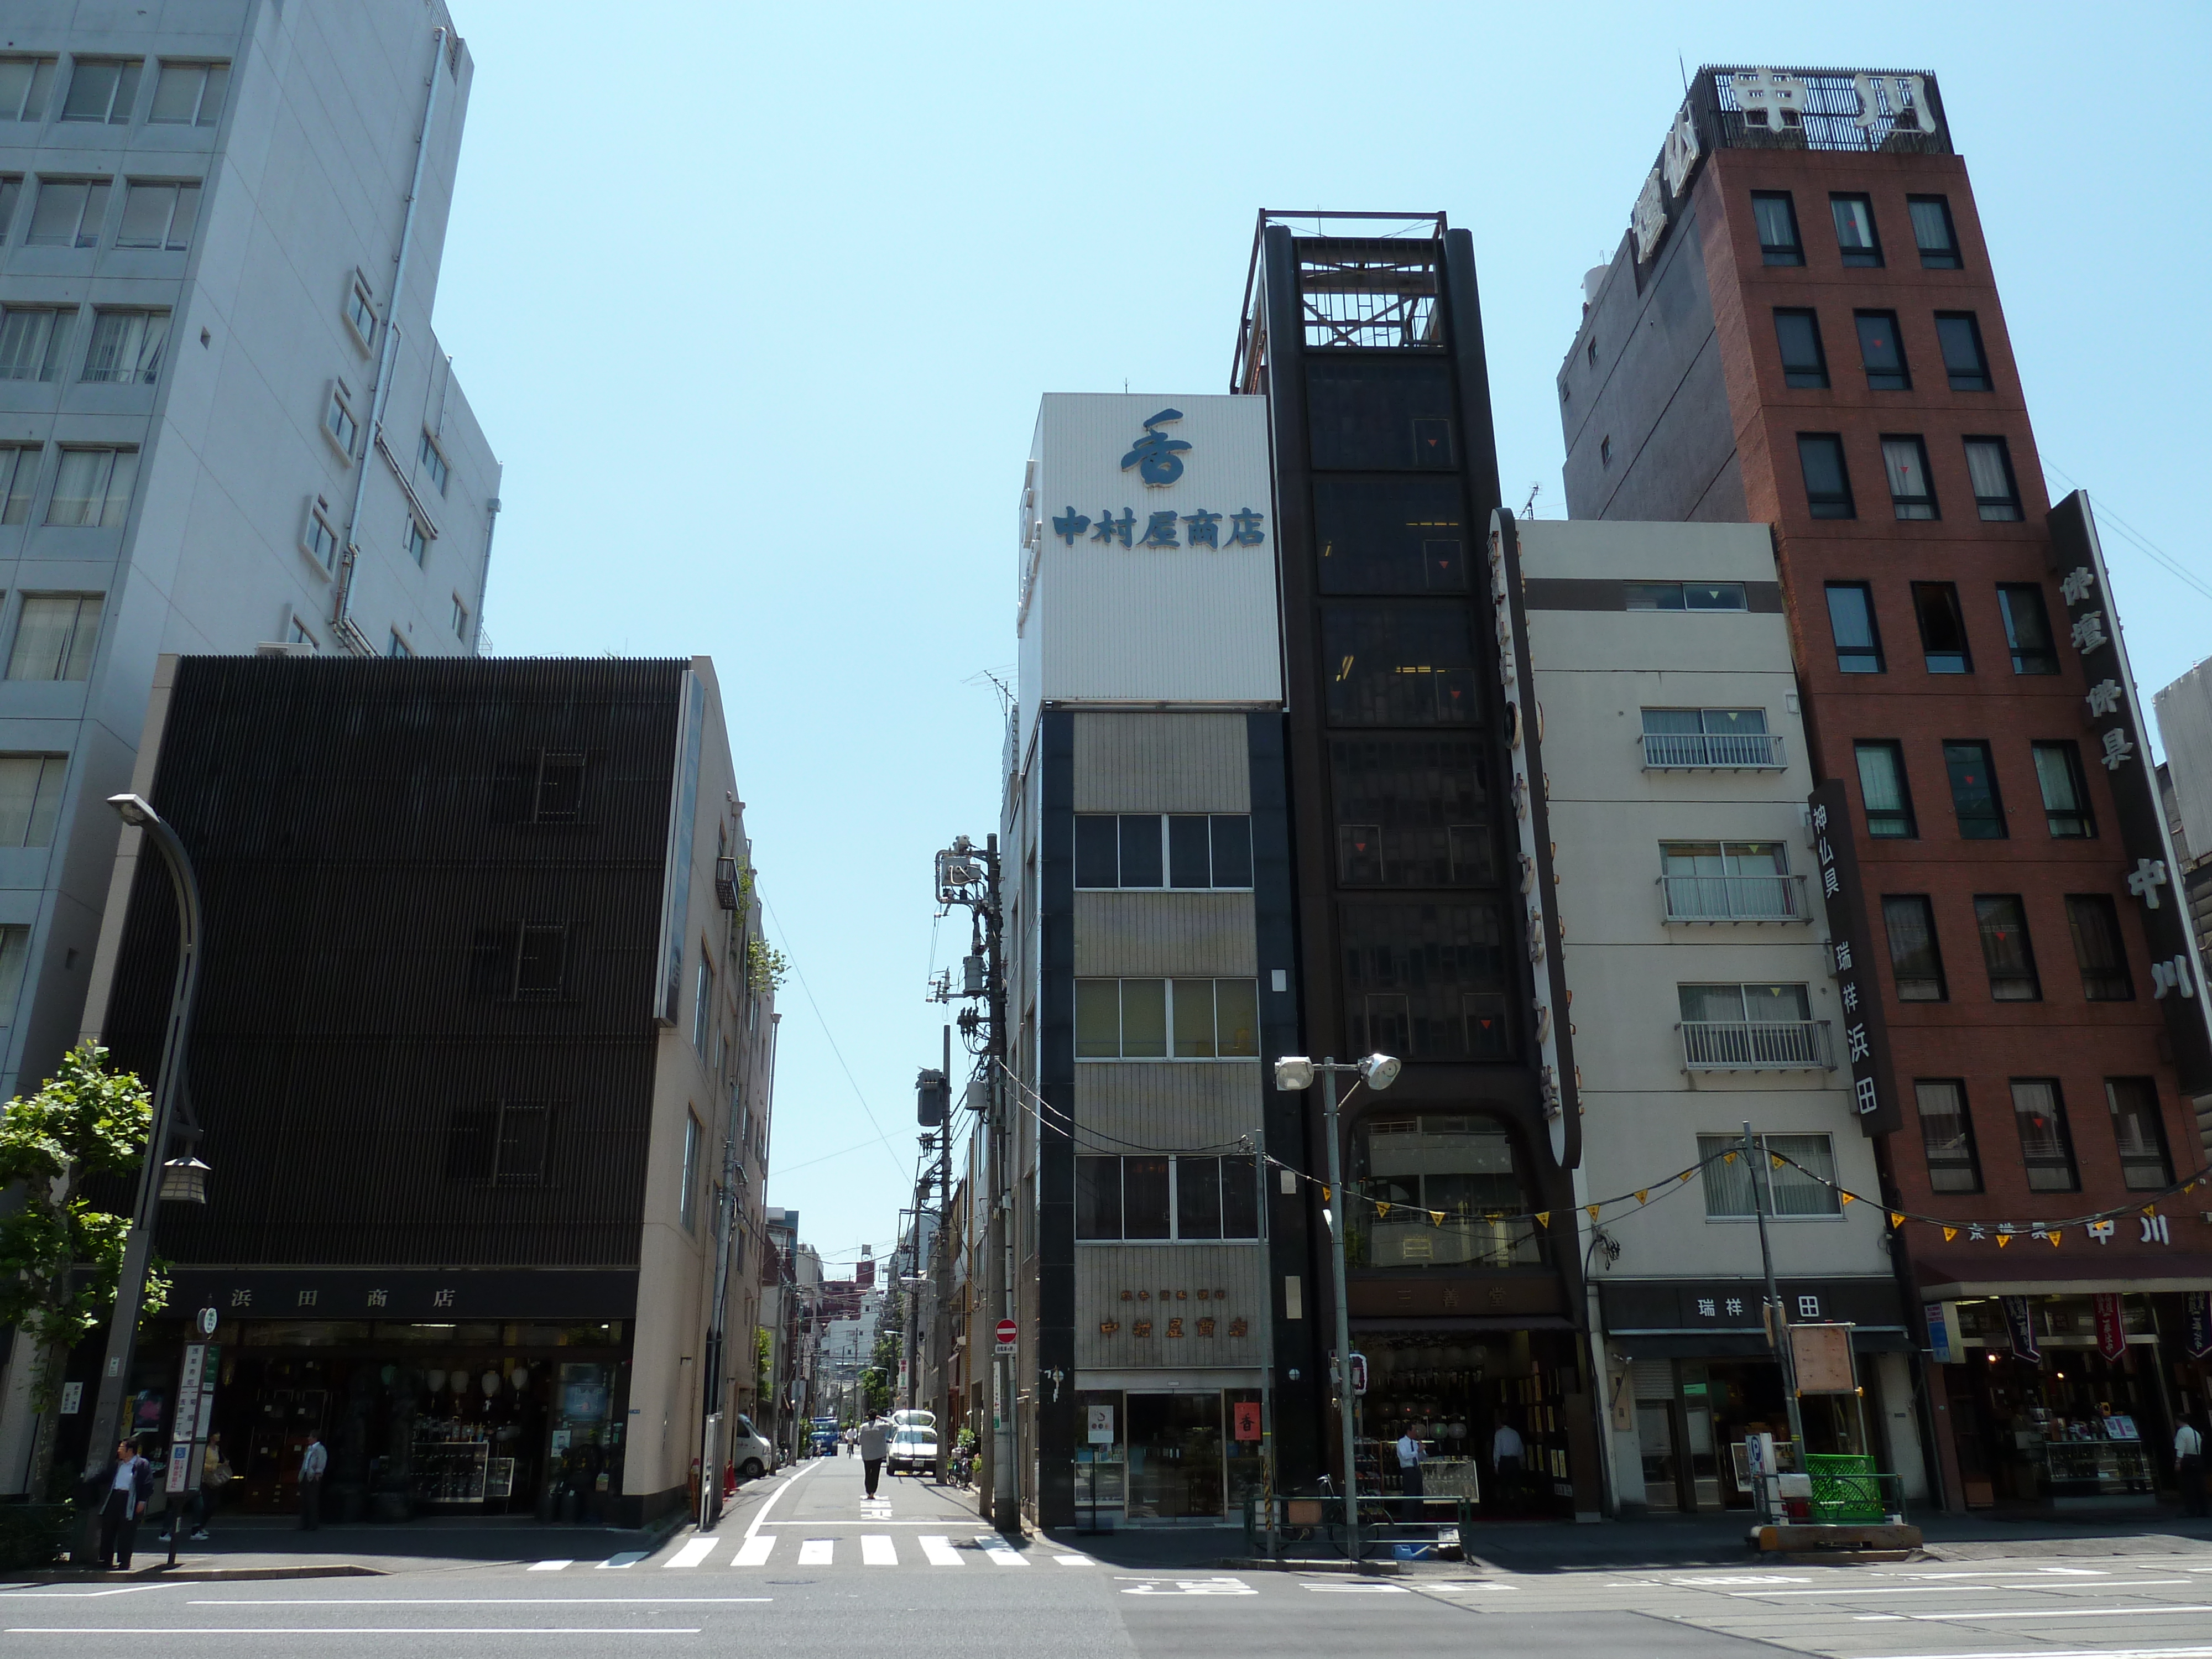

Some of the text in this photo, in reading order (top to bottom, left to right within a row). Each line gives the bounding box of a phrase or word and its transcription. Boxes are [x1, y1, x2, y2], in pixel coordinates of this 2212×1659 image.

[1731, 67, 1936, 134] 中川
[1120, 408, 1193, 488] 香
[1052, 505, 1265, 551] 中村屋商店
[2127, 857, 2194, 1000] 中川
[1813, 803, 1877, 1115] 神仏具 瑞祥浜田
[2085, 1214, 2170, 1246] 中川
[231, 1288, 456, 1307] 浜田商店
[1397, 1286, 1507, 1308] 三善堂
[1698, 1295, 1819, 1318] 瑞祥田
[1100, 1317, 1248, 1338] 中村屋商店
[1239, 1412, 1255, 1431] 香
